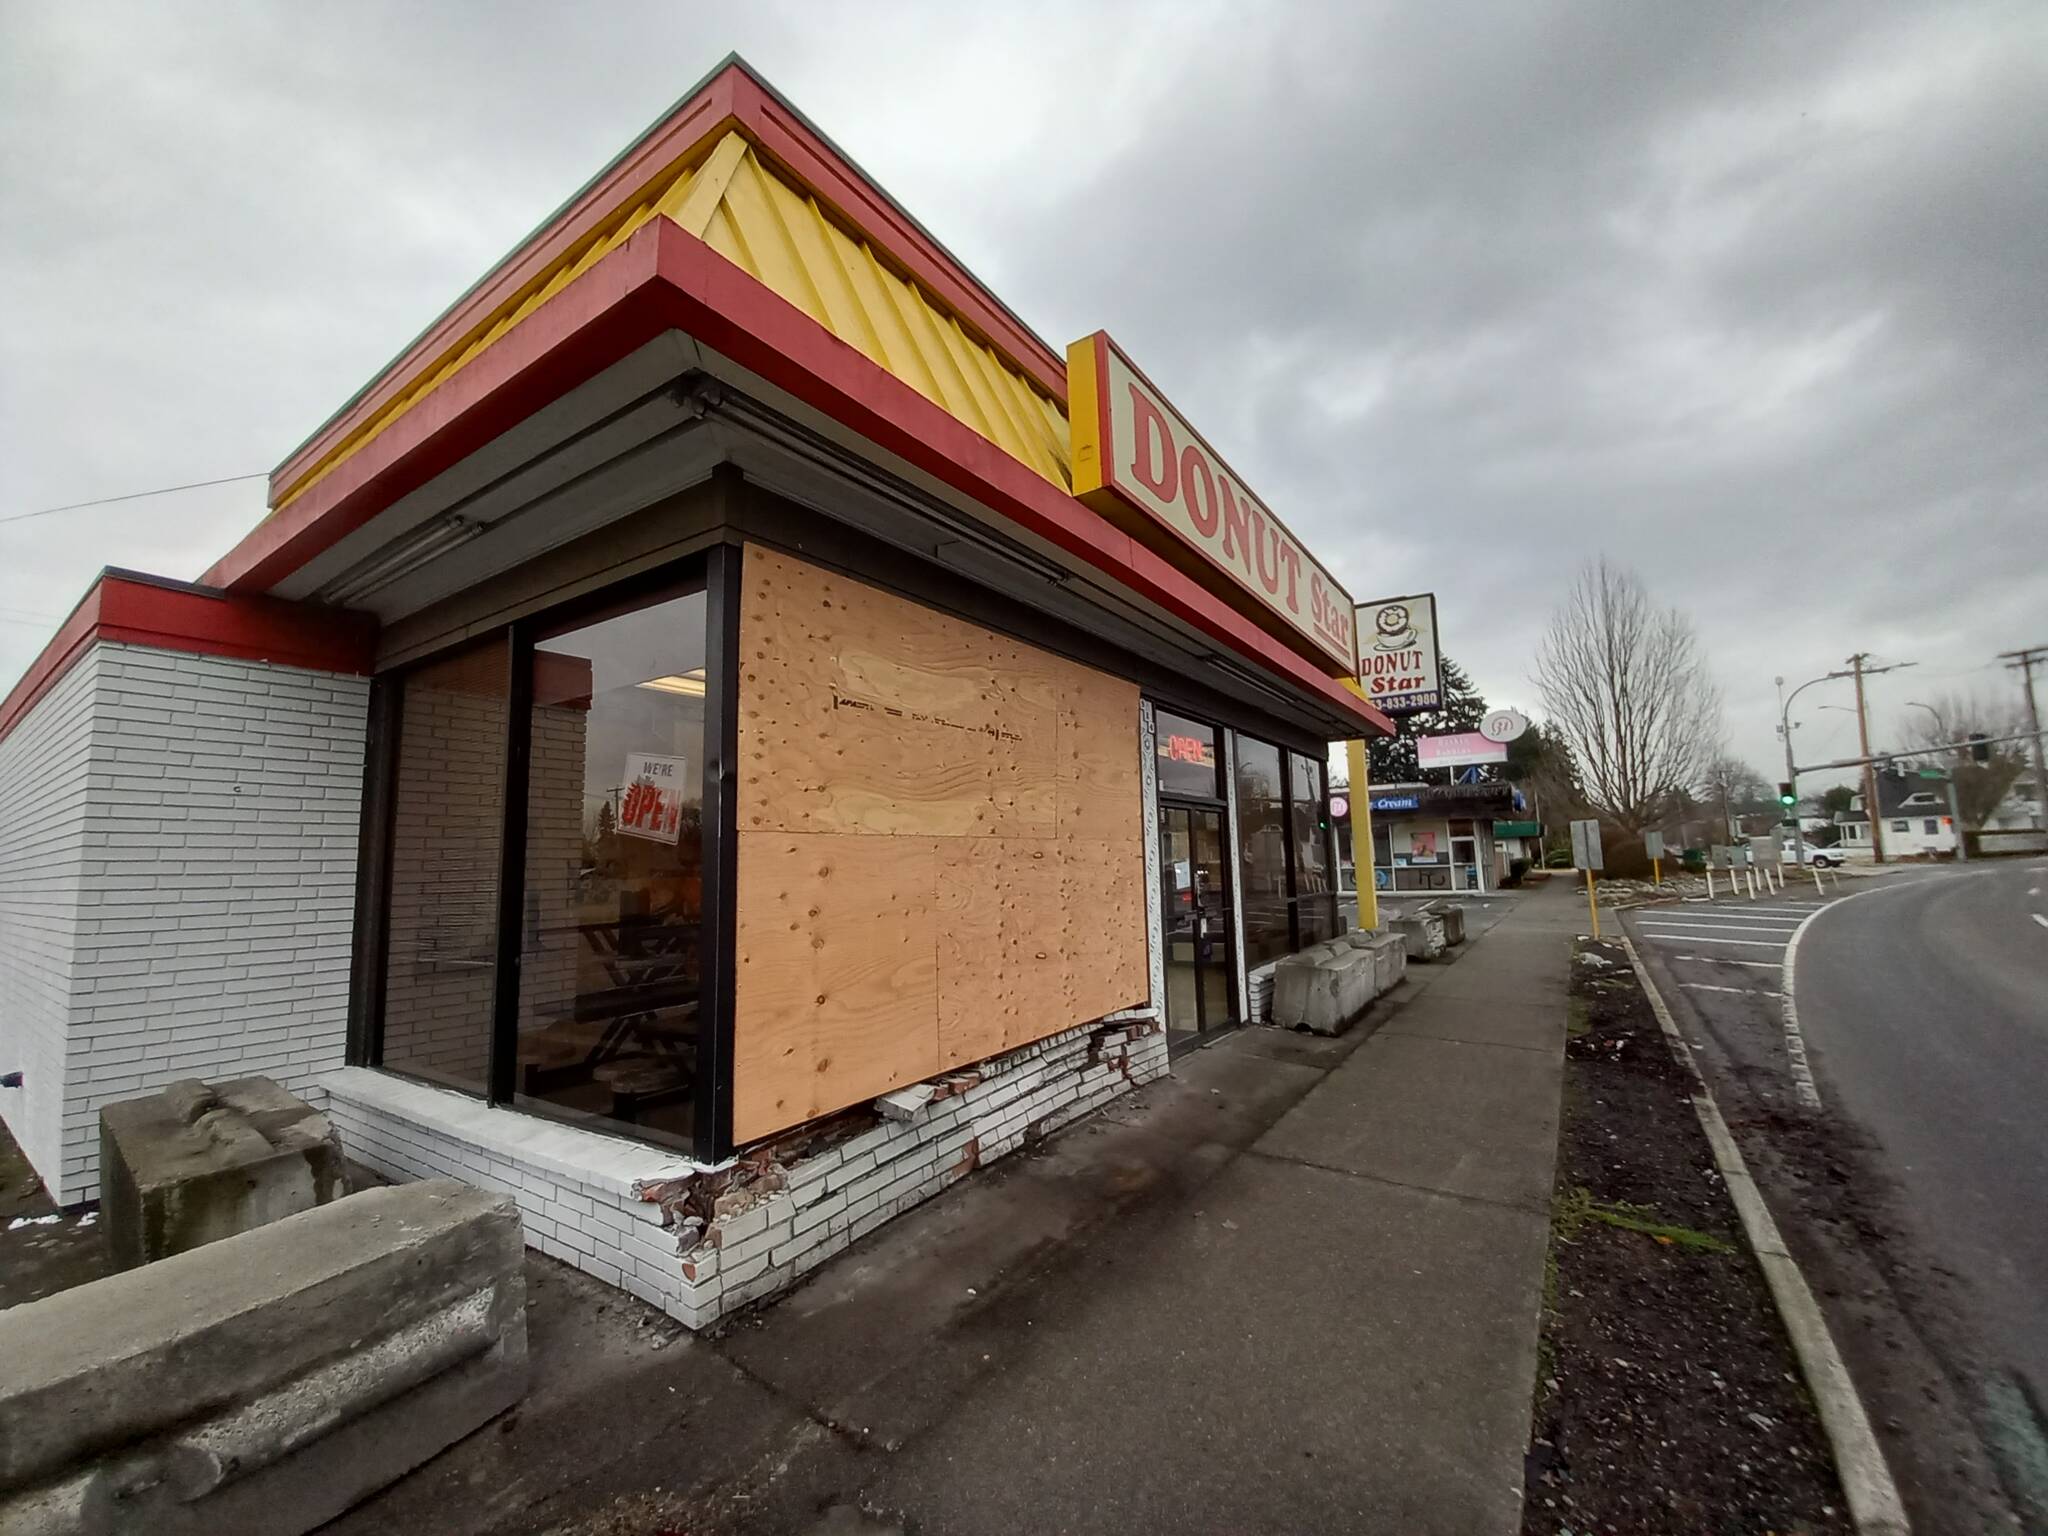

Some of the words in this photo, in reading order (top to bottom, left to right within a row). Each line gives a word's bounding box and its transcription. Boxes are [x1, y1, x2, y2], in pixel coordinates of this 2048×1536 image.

[1127, 381, 1302, 615] DONUT
[1310, 571, 1349, 646] Star
[1361, 650, 1424, 676] DONUT
[1370, 676, 1425, 694] Star
[1168, 735, 1204, 763] OPEN
[643, 762, 673, 777] WE'RE
[622, 782, 680, 834] OPEN
[1377, 798, 1413, 810] Cream
